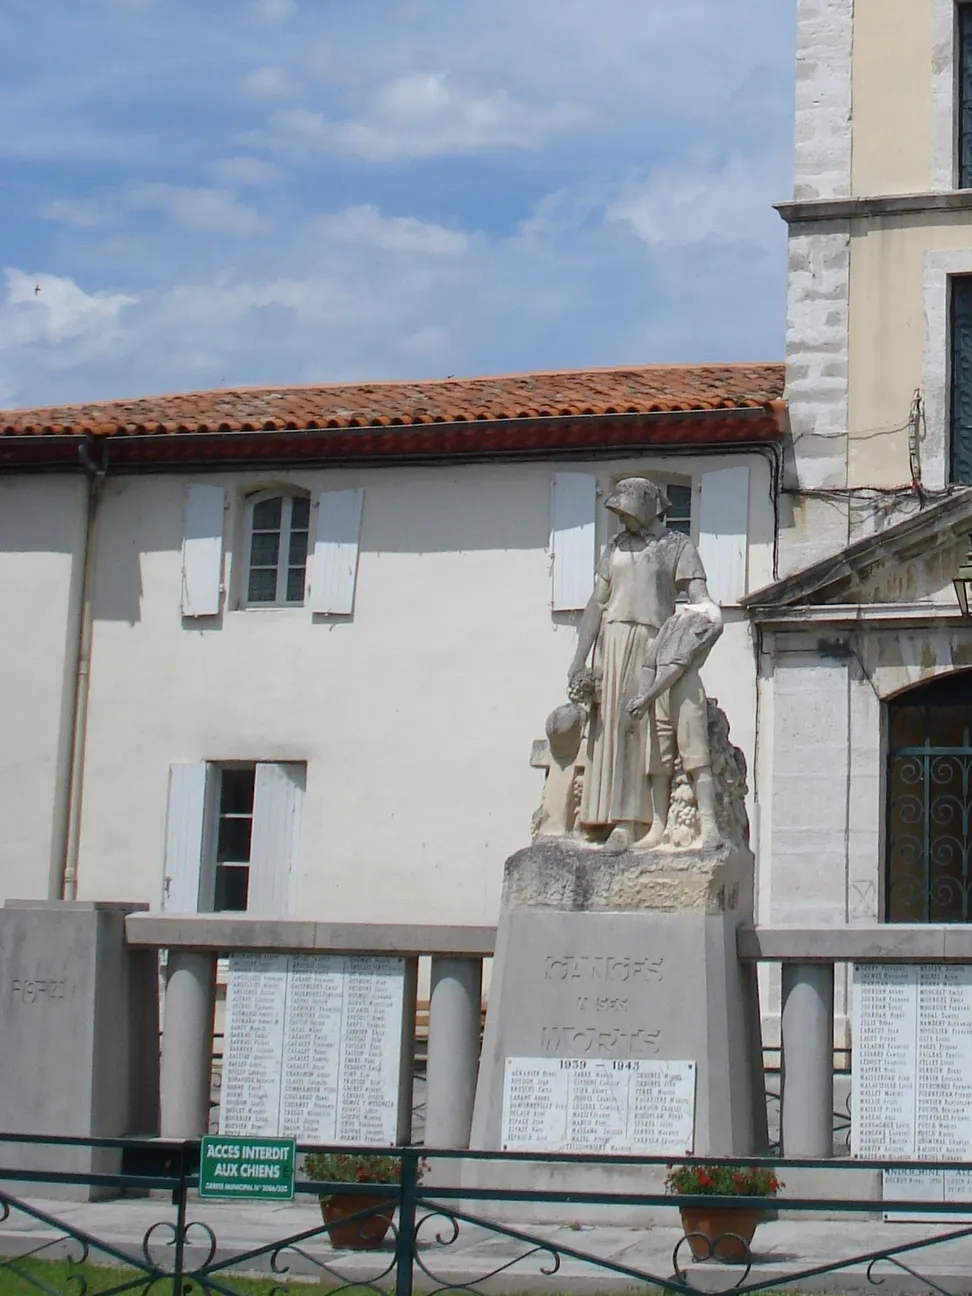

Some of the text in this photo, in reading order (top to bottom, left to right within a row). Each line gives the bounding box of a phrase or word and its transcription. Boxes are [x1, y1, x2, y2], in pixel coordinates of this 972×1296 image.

[207, 1144, 290, 1160] ACCES INTERDIT
[214, 1163, 280, 1178] AUX CHIENS
